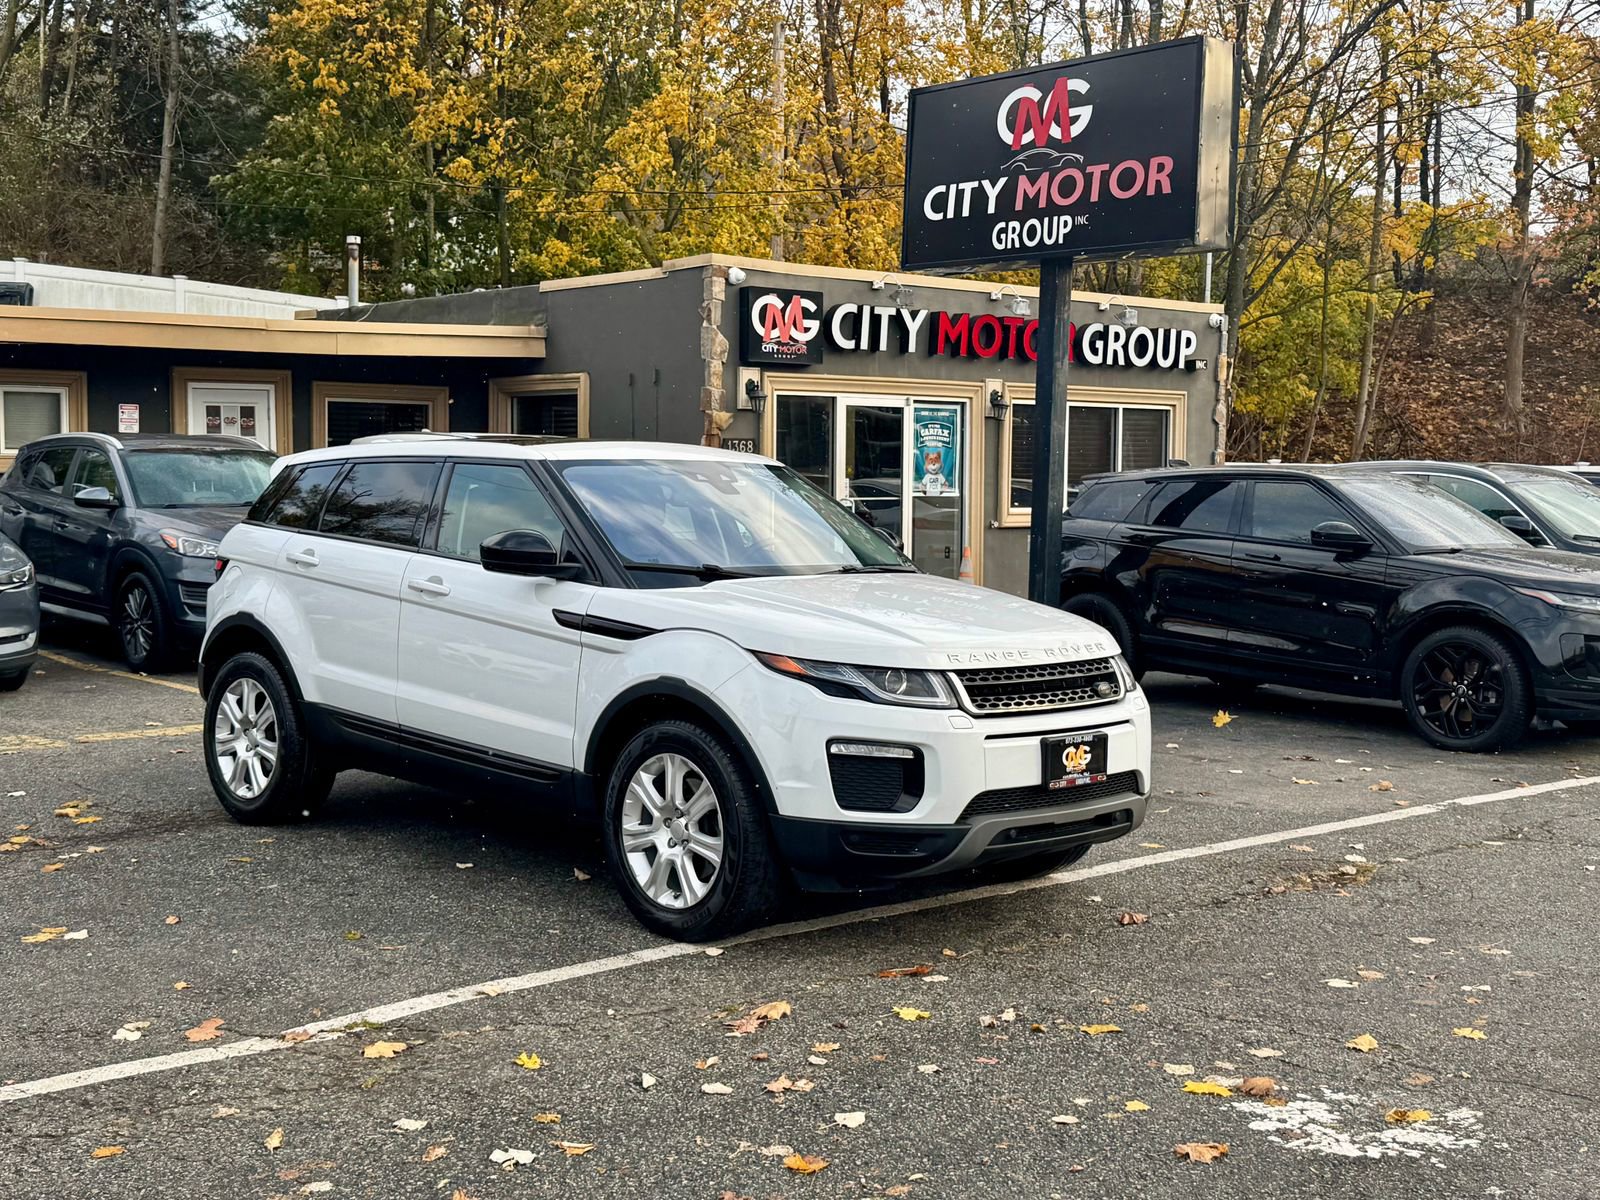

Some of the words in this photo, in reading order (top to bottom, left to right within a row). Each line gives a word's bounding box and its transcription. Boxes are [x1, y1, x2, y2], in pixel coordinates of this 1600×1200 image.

[923, 176, 1009, 222] CITY
[1015, 155, 1174, 211] MOTOR
[991, 214, 1073, 250] GROUP
[1075, 213, 1089, 226] INC
[830, 303, 928, 354] CITY
[937, 310, 1077, 364] MOTO
[1081, 322, 1198, 369] GROUP
[1195, 359, 1208, 370] INC
[779, 345, 807, 355] MOTOR
[921, 428, 950, 438] CARFAX
[727, 440, 754, 453] 1368
[946, 650, 1032, 664] RANGE
[1042, 642, 1107, 658] ROVER
